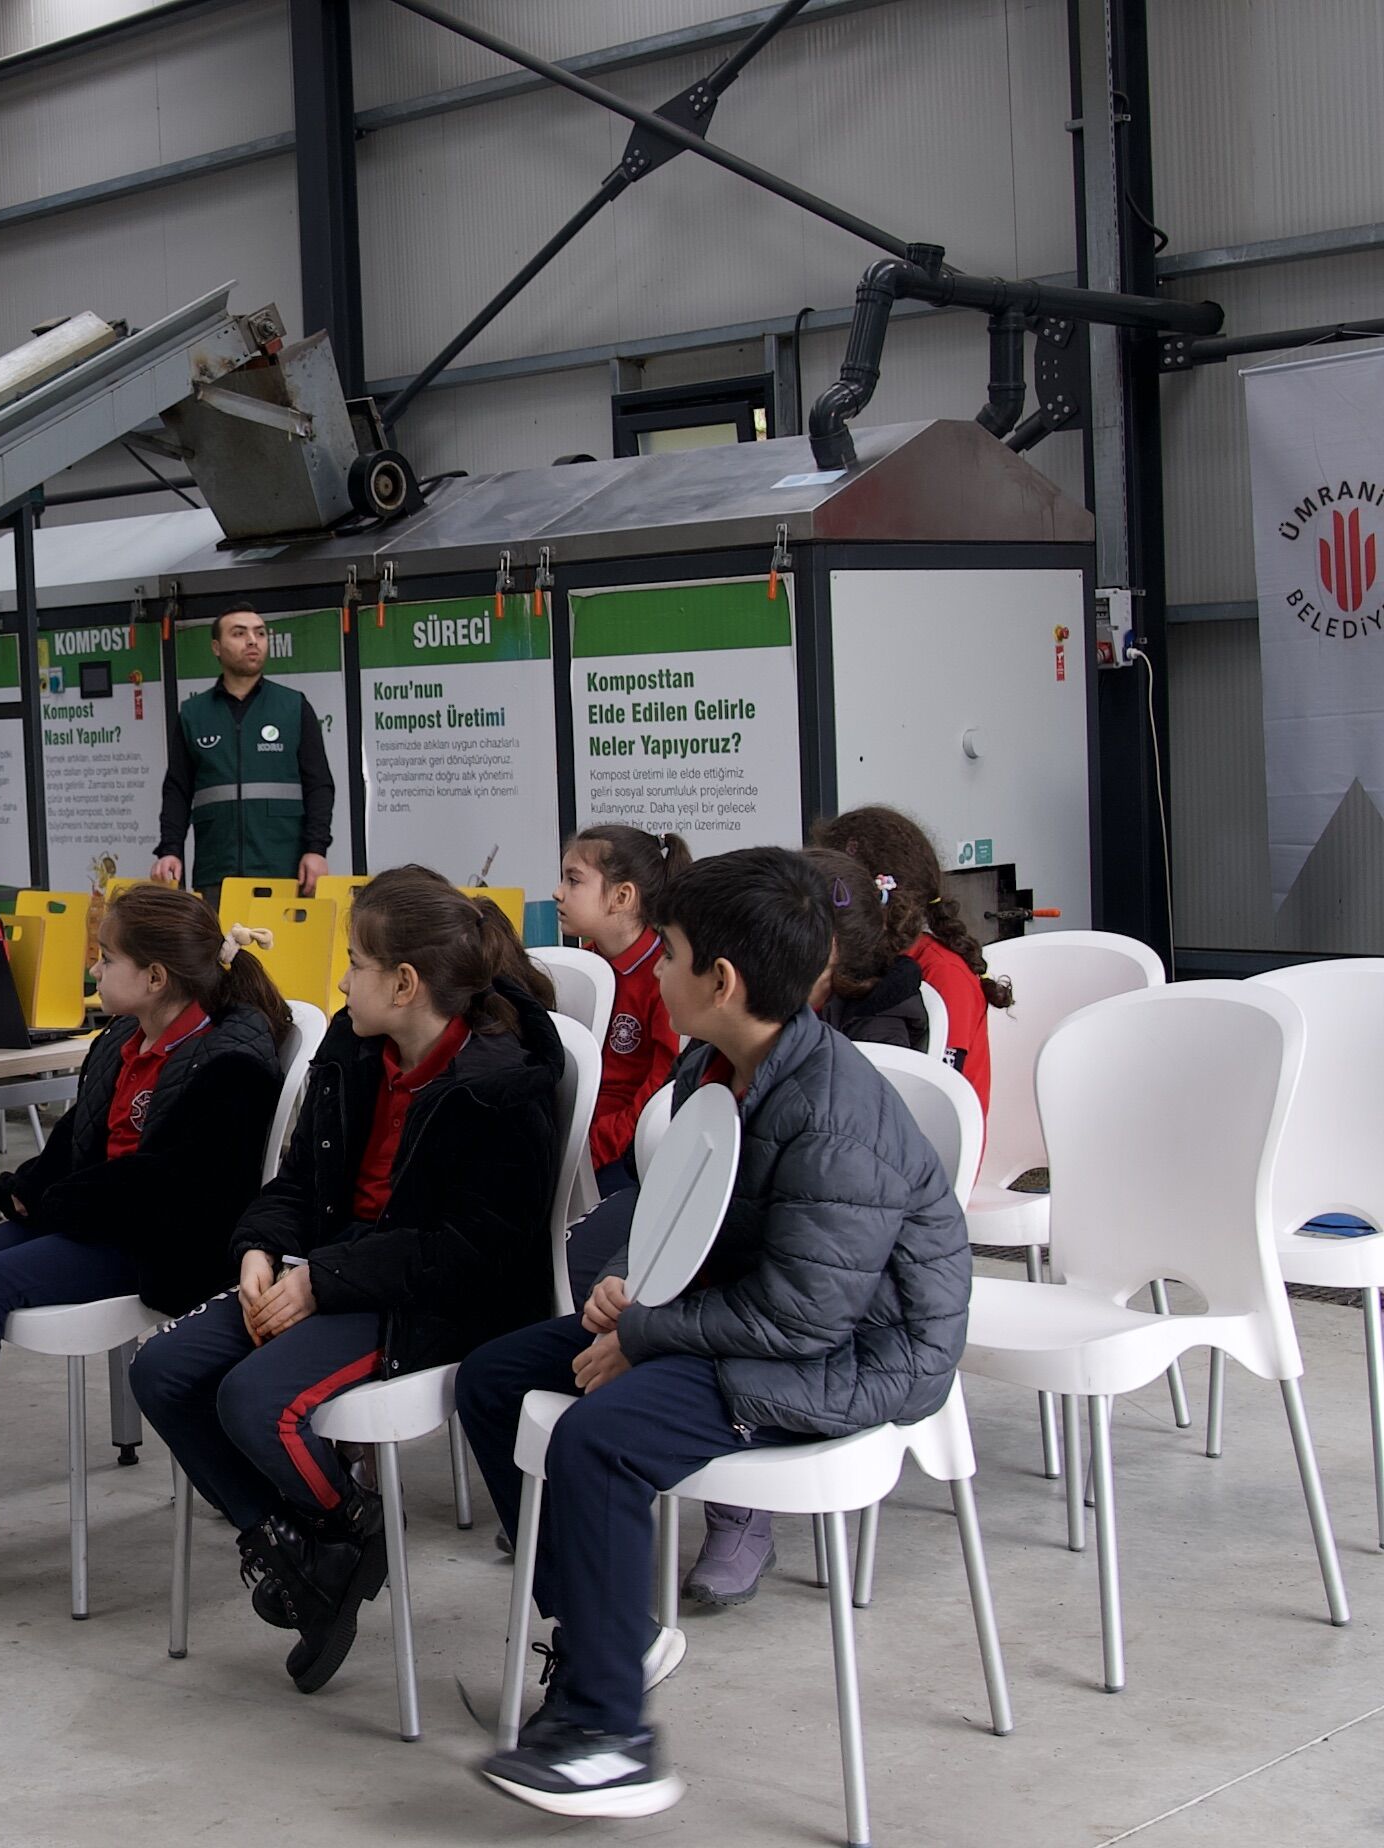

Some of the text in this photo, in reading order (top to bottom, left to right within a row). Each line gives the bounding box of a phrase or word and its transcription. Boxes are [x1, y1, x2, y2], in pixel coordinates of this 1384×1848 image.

[1279, 481, 1384, 542] ÜMRANİ
[1286, 588, 1384, 639] BELEDİY
[413, 610, 492, 649] SÜRECİ
[54, 627, 130, 656] KOMPOST
[587, 669, 695, 695] Komposttan
[43, 702, 94, 722] Kompost
[375, 704, 505, 733] Kompost Üretimi
[588, 698, 756, 724] Elde Edilen Gelirle
[44, 726, 121, 748] Nasıl Yapılır?
[452, 740, 478, 752] uygun
[480, 738, 519, 748] cihazlarla
[589, 732, 742, 759] Neler Yapıyoruz?
[376, 755, 426, 768] parçalayarak
[428, 756, 445, 768] geri
[435, 770, 460, 783] doğru
[478, 769, 513, 782] yönetimi
[590, 766, 744, 782] Kompost üretimi ile elde ettiğimiz
[436, 786, 473, 796] korumak
[474, 786, 488, 798] için
[490, 785, 519, 796] önemli
[590, 784, 758, 800] geliri sosyal sorumluluk projelerinde
[377, 802, 387, 812] bir
[591, 802, 757, 816] kullanıyoruz. Daha yeşil bir gelecek
[646, 821, 673, 832] çevre
[676, 819, 692, 833] için
[694, 819, 741, 831] üzerimize
